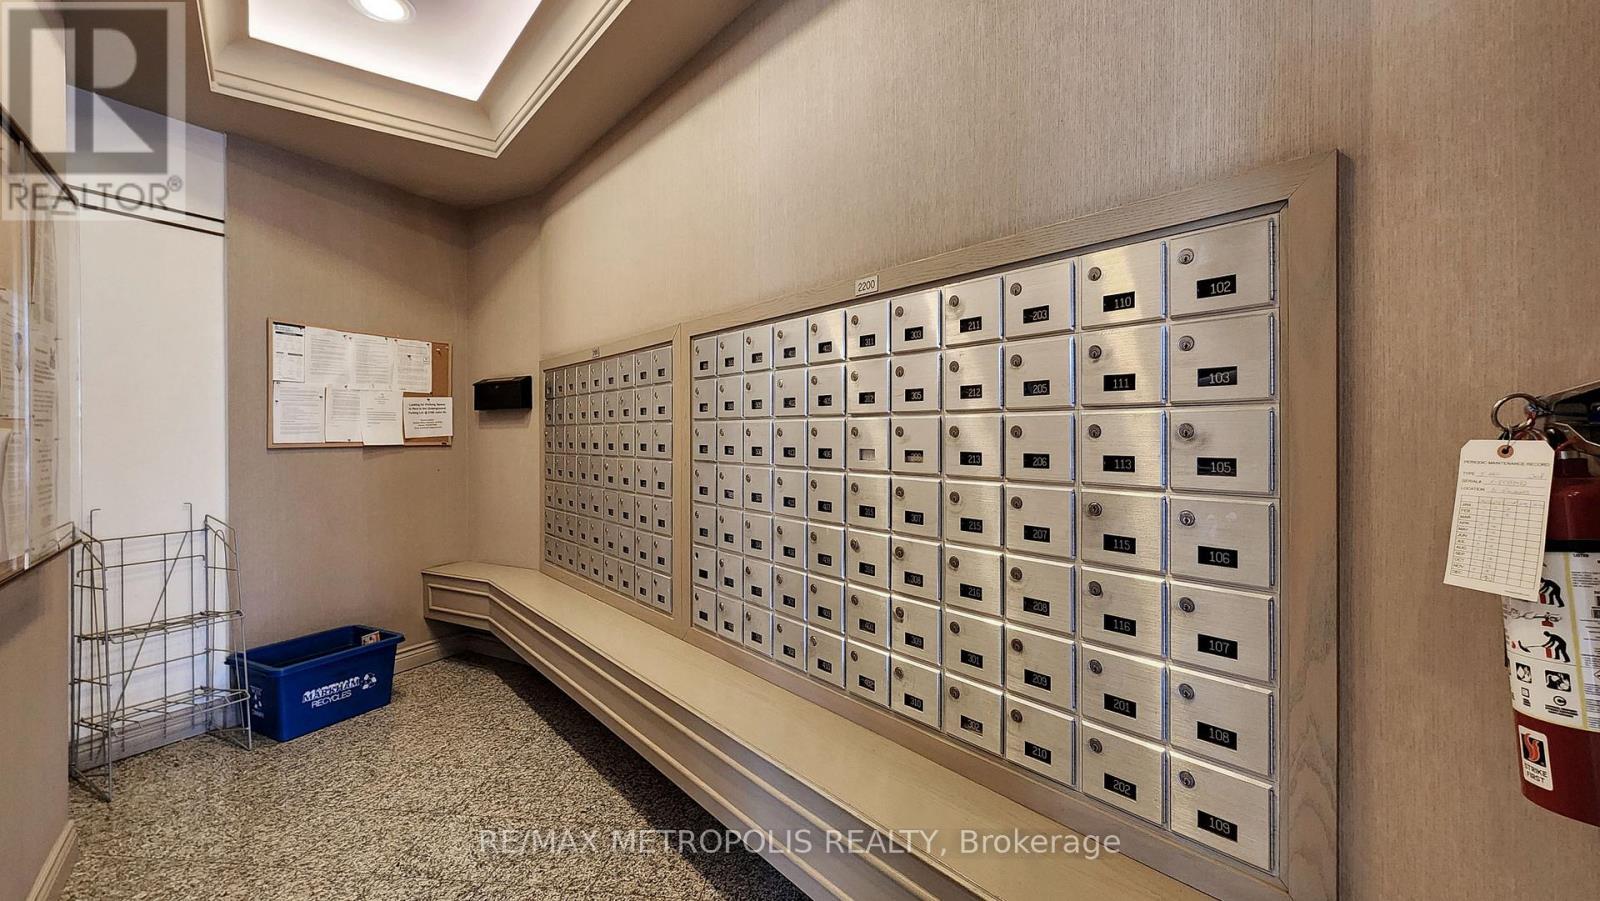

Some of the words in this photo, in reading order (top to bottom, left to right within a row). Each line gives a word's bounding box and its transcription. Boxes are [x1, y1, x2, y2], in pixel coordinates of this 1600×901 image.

[857, 279, 876, 292] 2200
[1210, 281, 1231, 295] 102
[1113, 296, 1132, 309] 110
[1032, 309, 1047, 320] 203
[1112, 377, 1129, 389] 111
[1208, 371, 1230, 384] 103
[968, 387, 980, 397] 212
[1032, 383, 1047, 394] 205
[968, 454, 980, 464] 213
[1032, 456, 1047, 467] 206
[1113, 459, 1132, 470] 113
[1210, 461, 1231, 473] 105
[1032, 529, 1047, 540] 207
[1113, 539, 1131, 551] 115
[1209, 551, 1230, 564] 106
[1032, 601, 1047, 613] 208
[1113, 619, 1130, 632] 116
[1209, 640, 1230, 654] 107
[311, 690, 352, 709] RECYCLES
[1113, 699, 1129, 714] 201
[1208, 728, 1230, 743] 108
[1032, 746, 1047, 760] 210
[1524, 762, 1548, 778] STRIKE
[1526, 770, 1545, 783] FIRST
[1113, 779, 1131, 796] 202
[1209, 817, 1230, 834] 109
